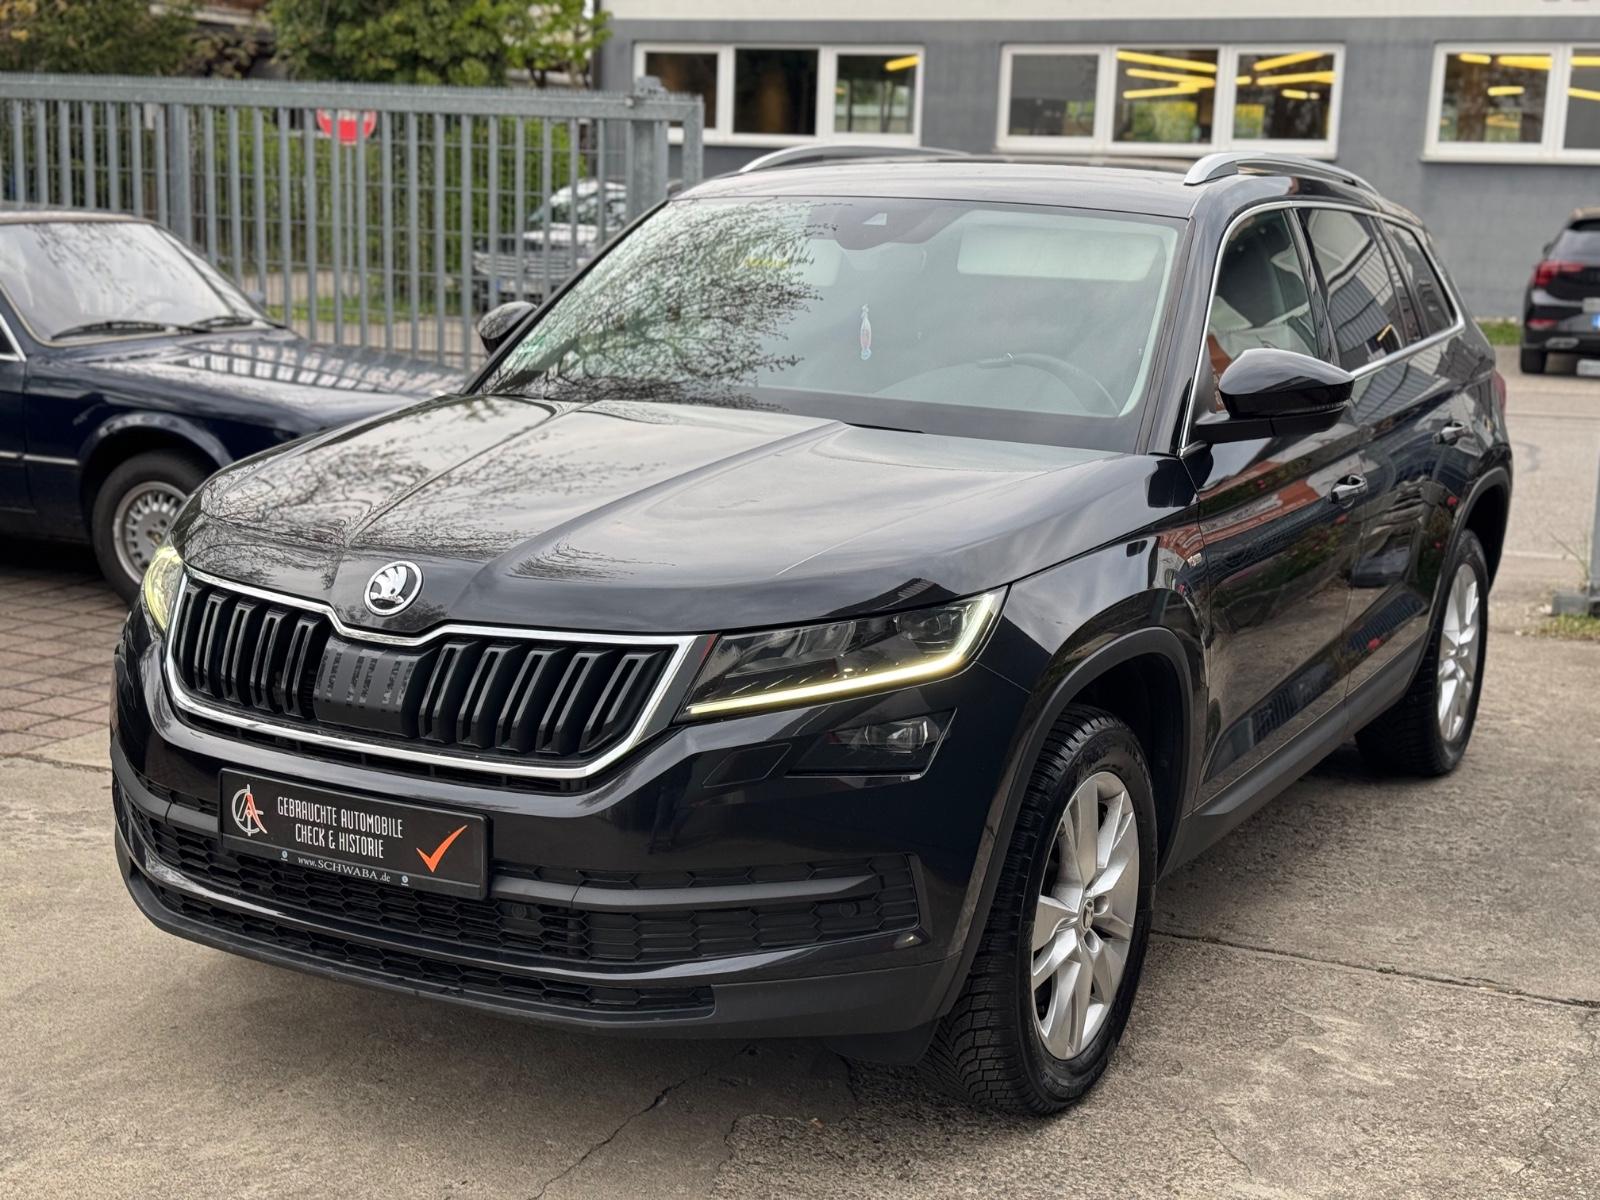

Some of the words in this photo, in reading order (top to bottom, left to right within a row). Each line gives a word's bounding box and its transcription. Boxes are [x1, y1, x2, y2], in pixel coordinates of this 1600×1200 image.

[277, 796, 337, 827] GEBRAUCHTE
[341, 809, 403, 839] AUTOMOBILE
[295, 823, 325, 847] CHECK
[329, 831, 336, 849] &
[338, 833, 384, 859] HISTORIE
